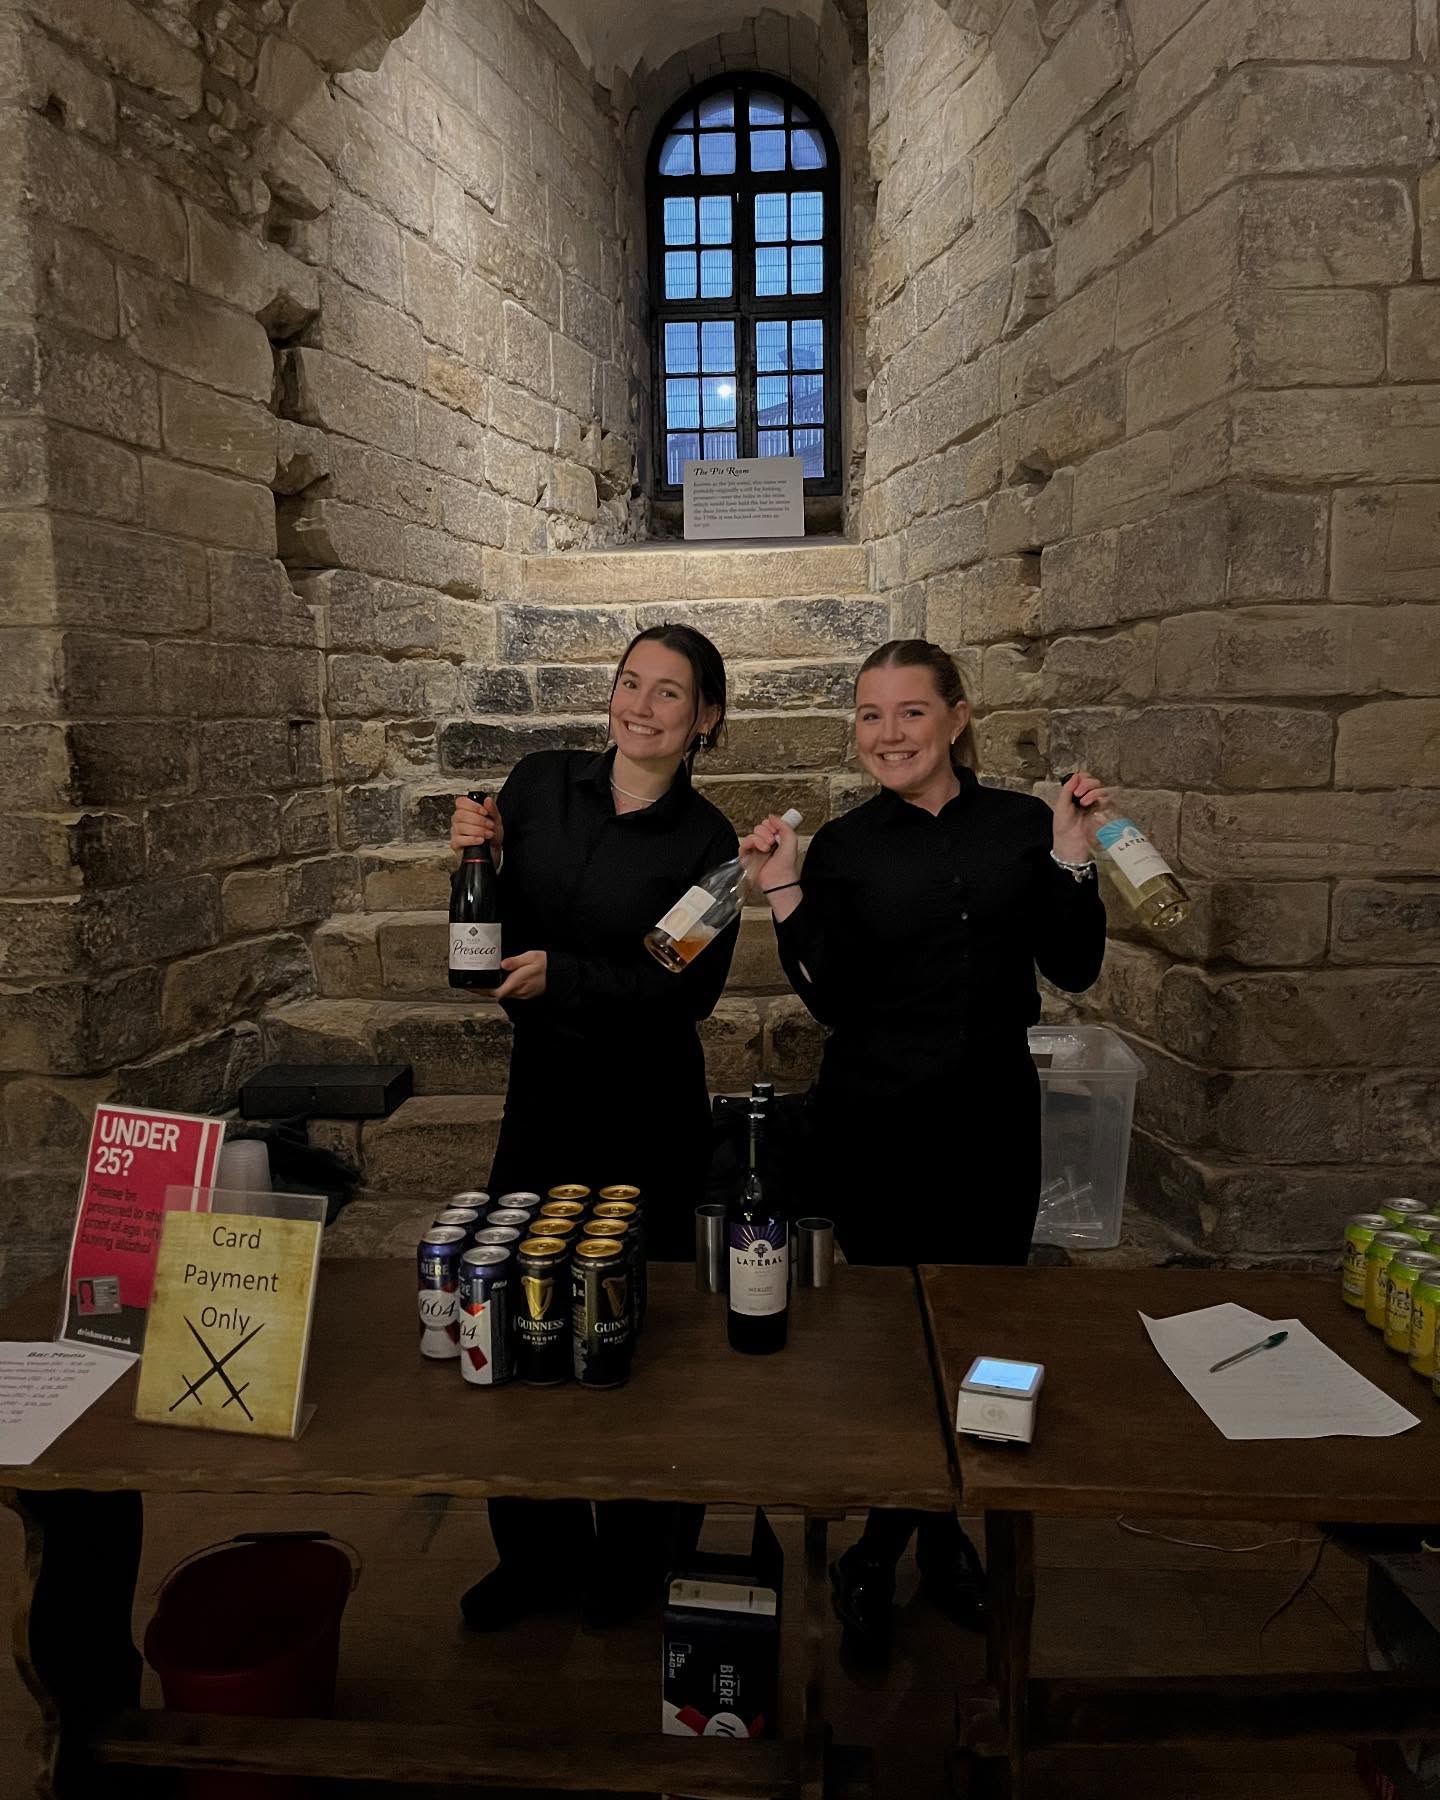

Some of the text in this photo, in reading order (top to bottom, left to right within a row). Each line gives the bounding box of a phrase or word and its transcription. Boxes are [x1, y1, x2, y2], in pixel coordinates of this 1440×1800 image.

[694, 466, 750, 477] The Pit Room
[453, 939, 496, 955] Prosecco
[100, 1115, 180, 1152] UNDER
[94, 1146, 134, 1176] 25?
[212, 1226, 262, 1249] Card
[736, 1256, 782, 1267] LATERAL
[184, 1264, 279, 1292] Payment
[201, 1306, 250, 1335] Only
[517, 1315, 564, 1331] GUINNESS
